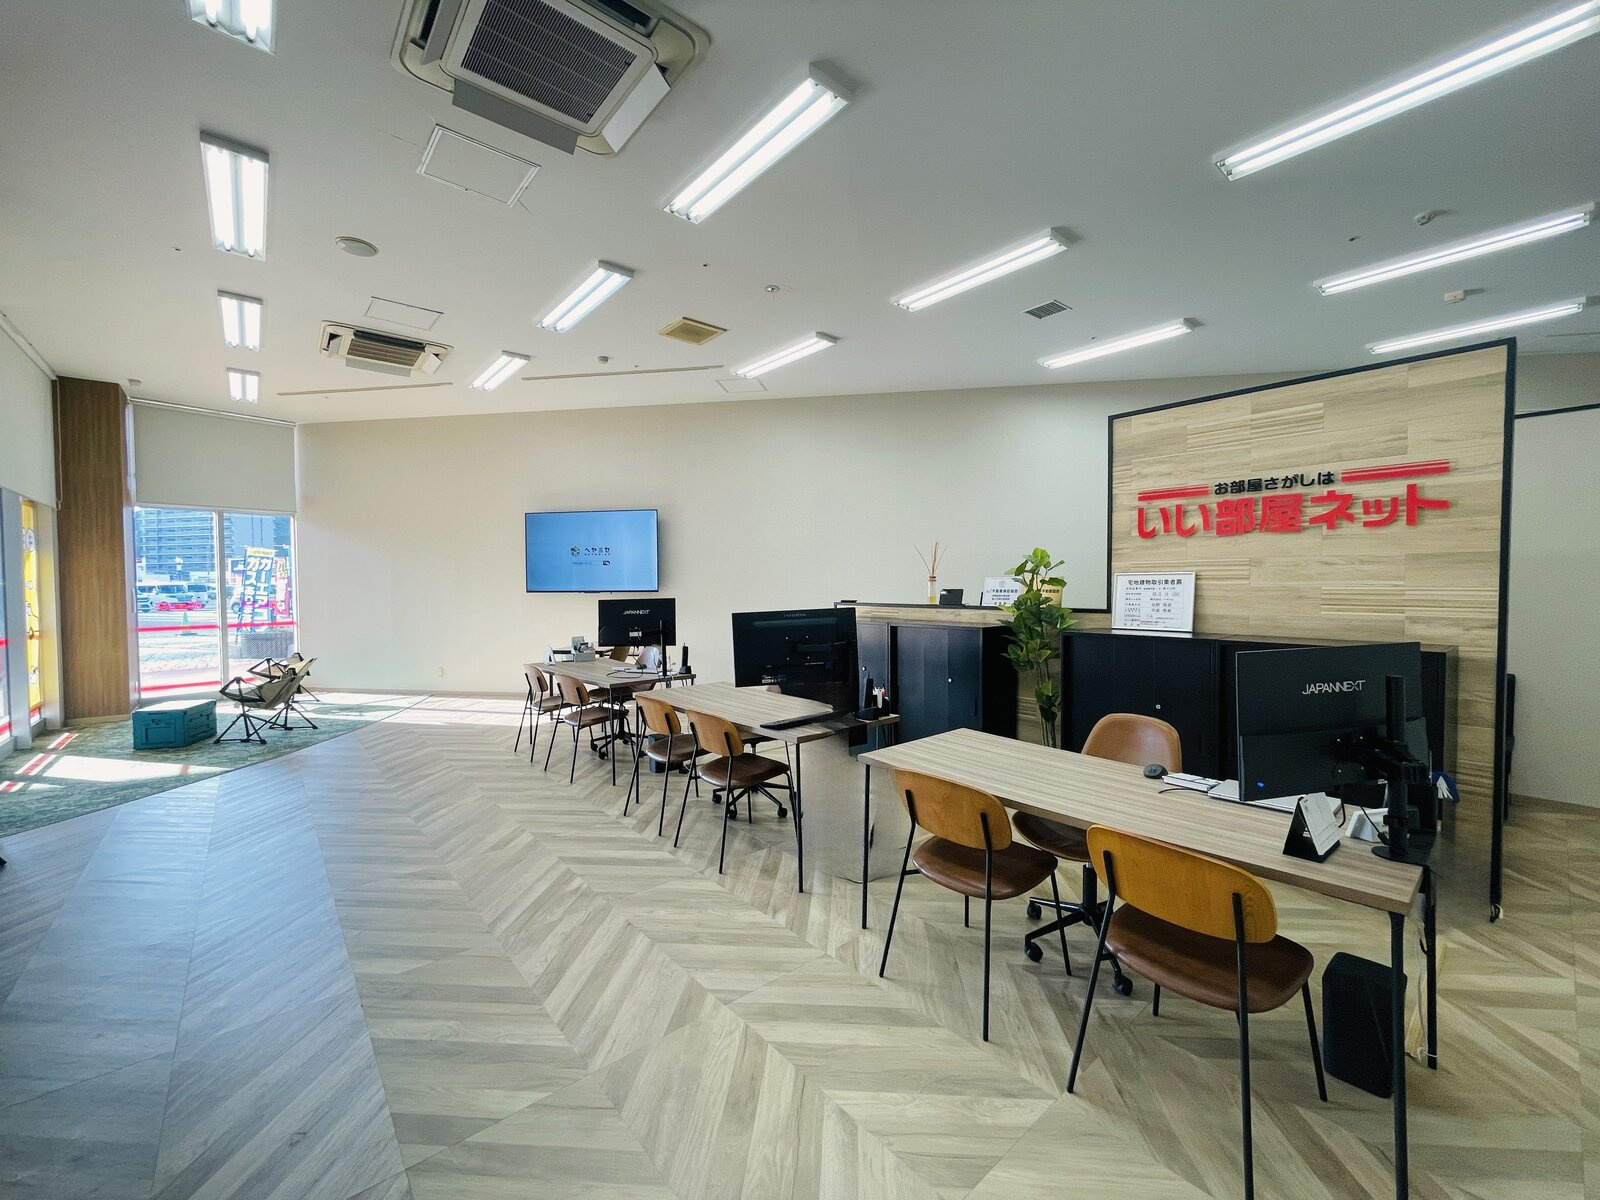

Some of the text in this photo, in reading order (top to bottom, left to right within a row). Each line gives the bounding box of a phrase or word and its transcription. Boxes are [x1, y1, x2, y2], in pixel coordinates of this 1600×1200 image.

[1213, 471, 1335, 496] お部屋さがしは
[1137, 483, 1452, 539] いい部屋ネット
[1302, 680, 1366, 695] JAPANNEXT
